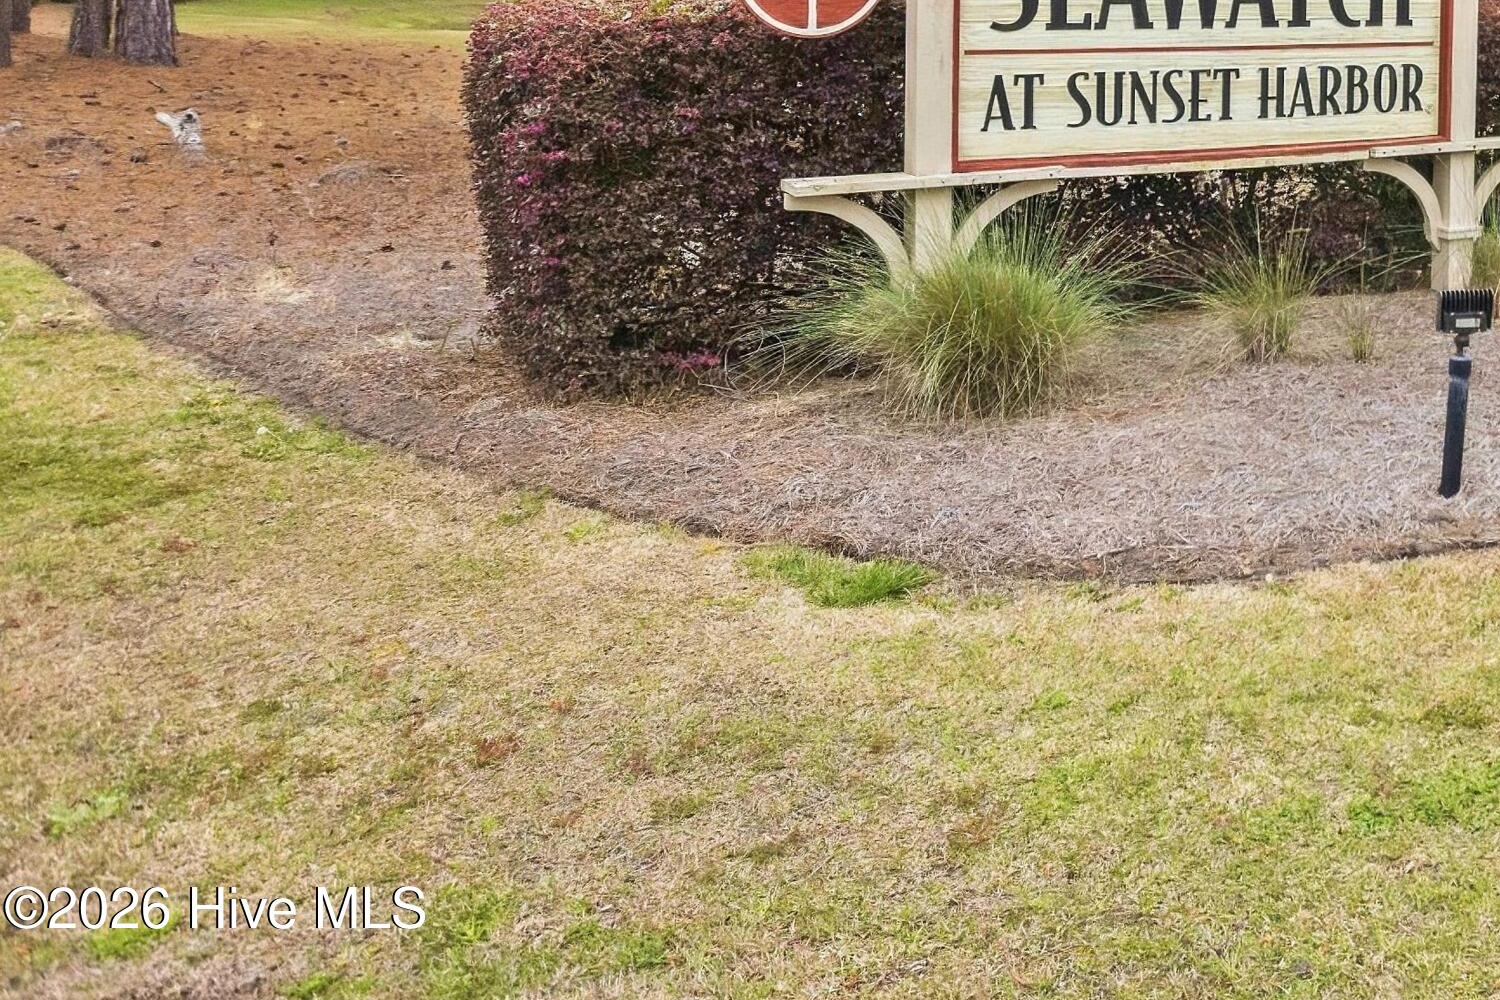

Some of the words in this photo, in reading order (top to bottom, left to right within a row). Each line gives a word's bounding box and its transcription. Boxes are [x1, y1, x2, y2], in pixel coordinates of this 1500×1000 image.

[980, 73, 1044, 131] AT
[1066, 68, 1239, 127] SUNSET
[1257, 63, 1423, 117] HARBOR
